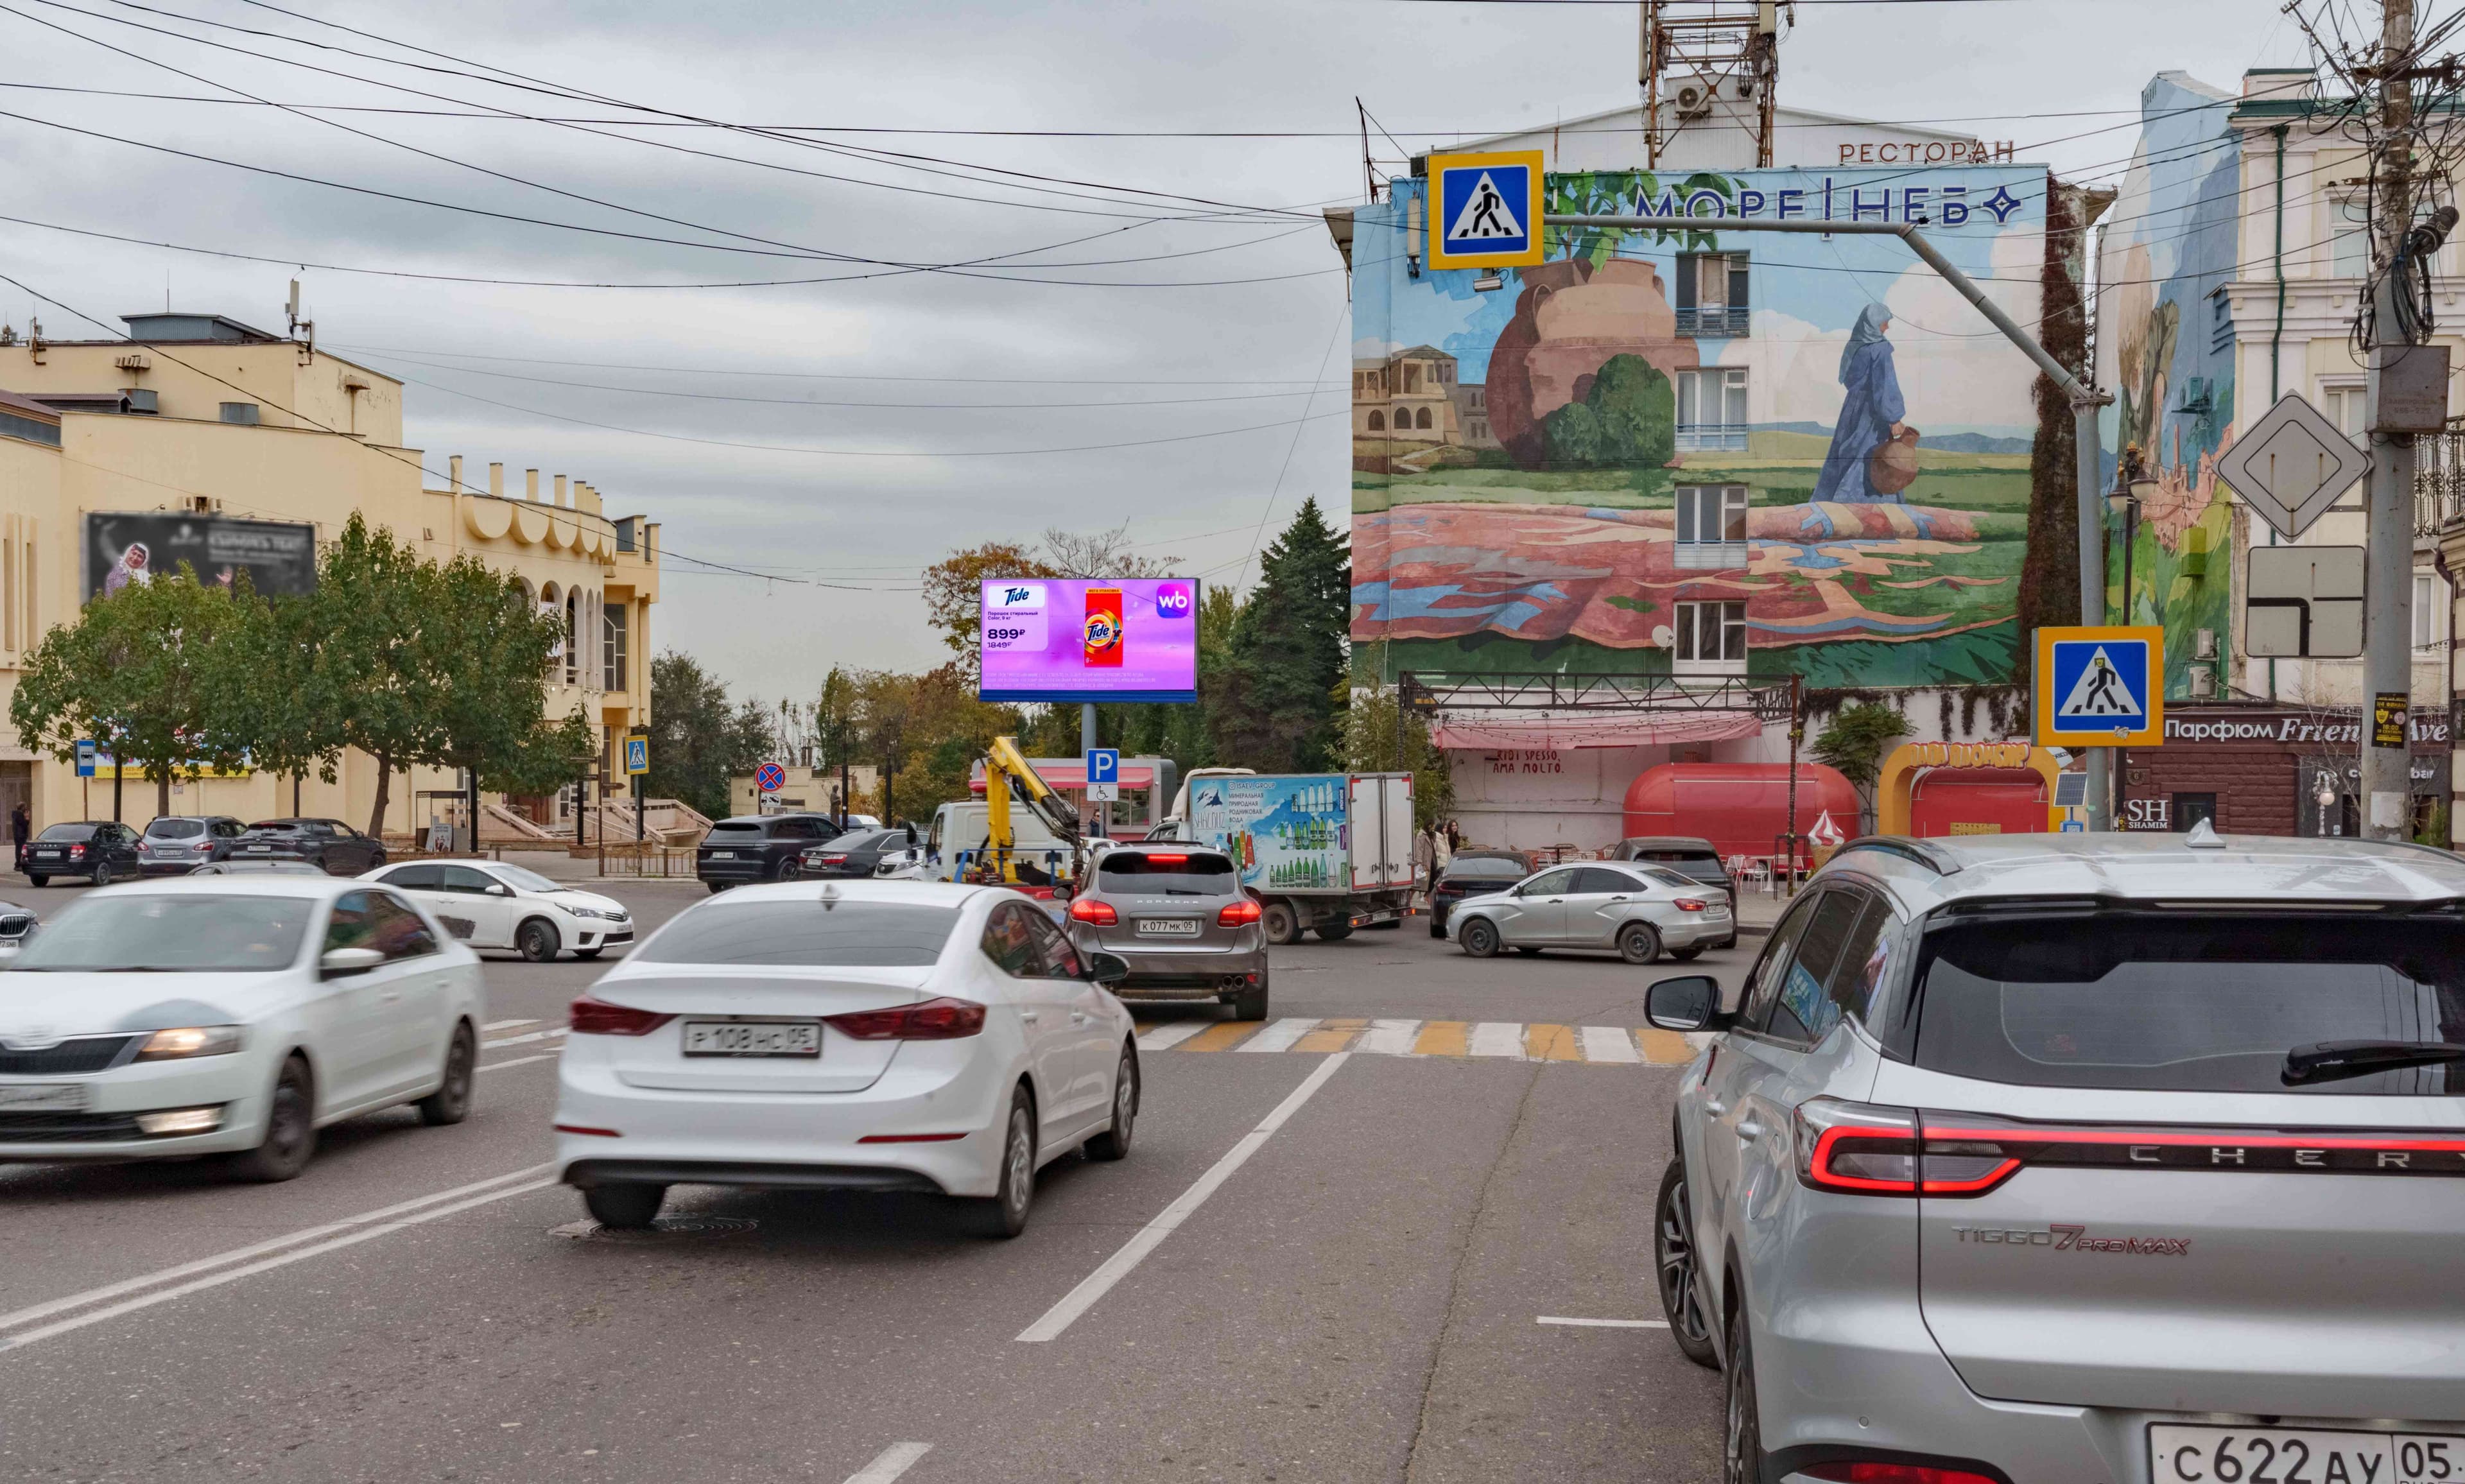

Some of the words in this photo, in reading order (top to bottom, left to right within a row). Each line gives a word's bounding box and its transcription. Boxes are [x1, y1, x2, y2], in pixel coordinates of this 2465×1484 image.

[1838, 141, 2014, 163] РЕСТОРАН
[1005, 587, 1030, 607] Tide
[1158, 590, 1188, 608] wb
[1087, 624, 1110, 642] Tide
[2165, 719, 2274, 742] Парфюм
[1095, 753, 1113, 780] P
[1492, 763, 1515, 773] AMA
[2127, 799, 2168, 822] SH
[2129, 1145, 2465, 1168] CHER
[2400, 1441, 2452, 1479] 05
